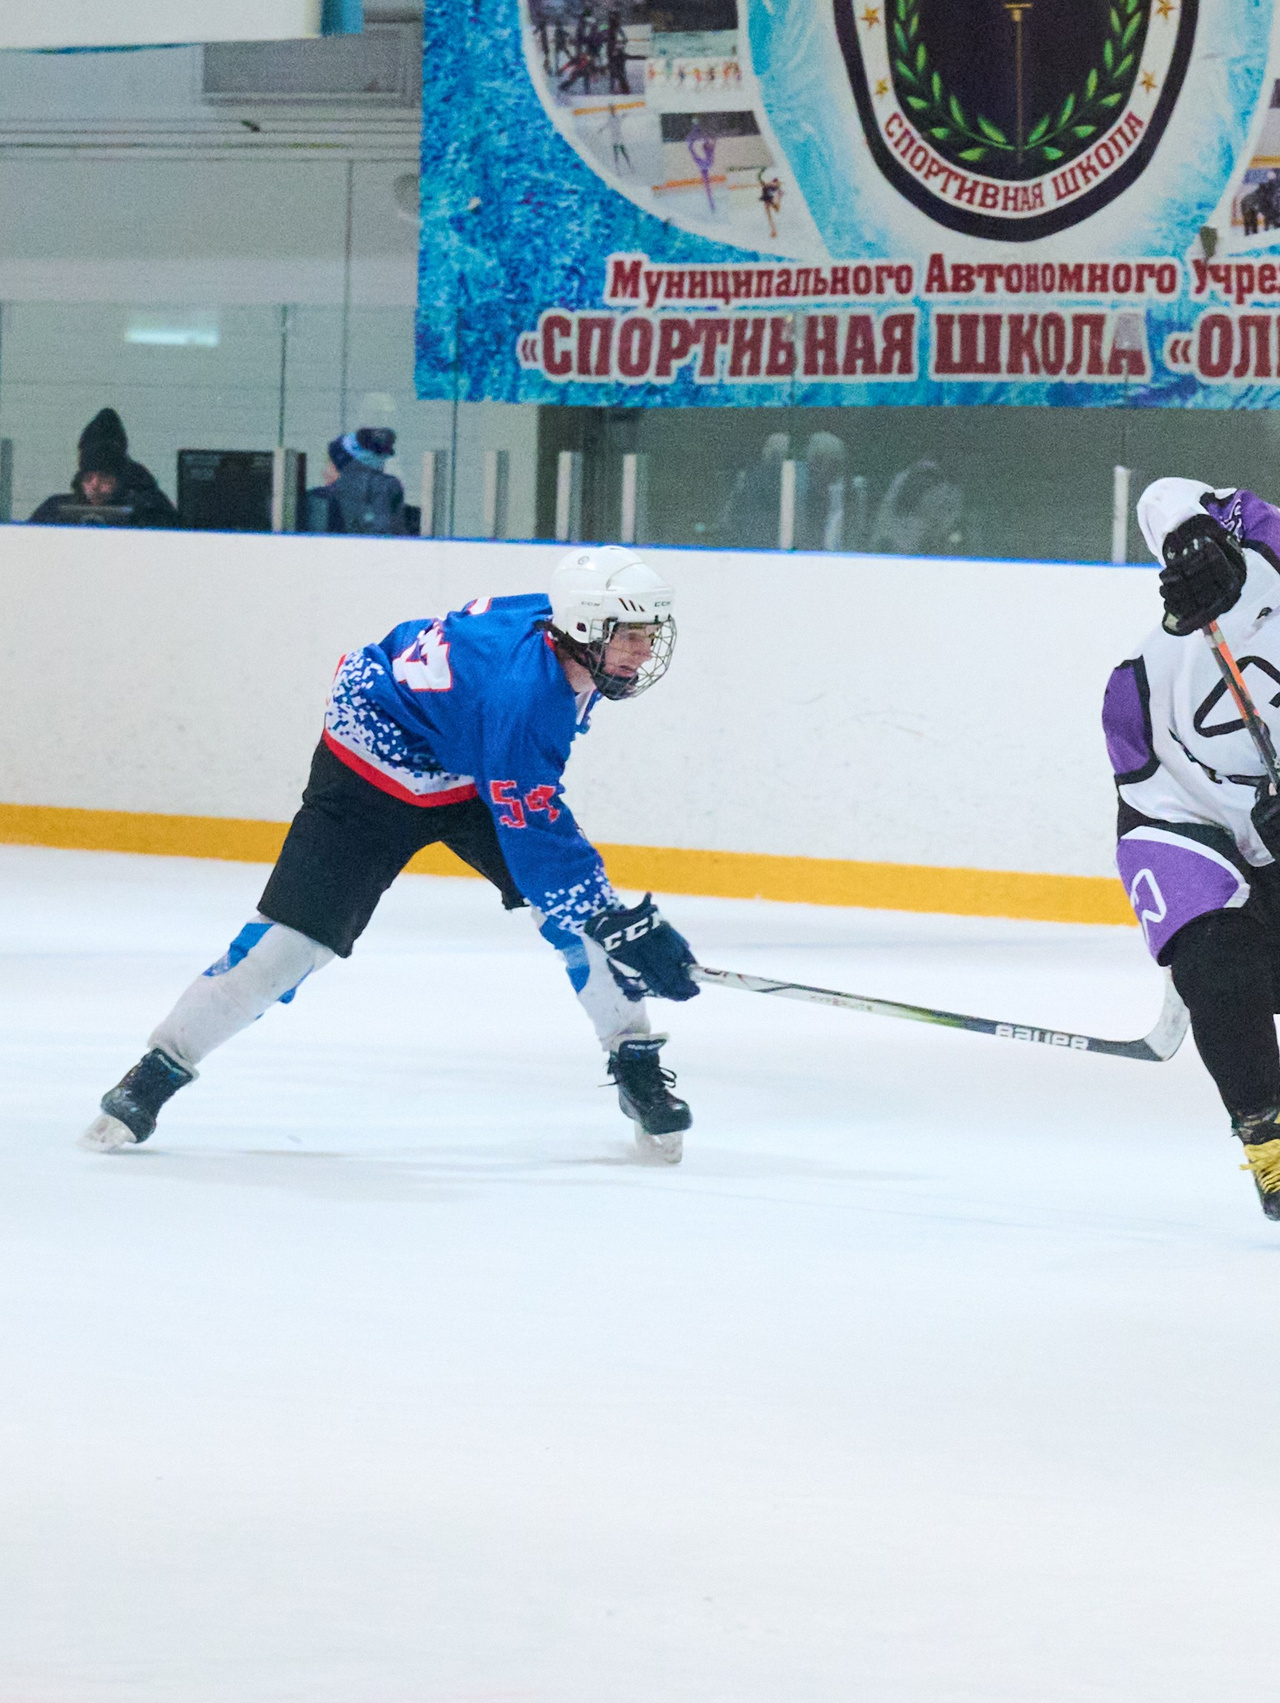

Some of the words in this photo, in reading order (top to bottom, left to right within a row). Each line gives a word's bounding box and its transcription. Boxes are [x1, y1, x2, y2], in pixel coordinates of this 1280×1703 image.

[884, 112, 1045, 212] СПОРТИВНАЯ
[1052, 110, 1144, 200] ШКОЛА
[610, 260, 913, 308] Муниципального
[925, 253, 1176, 294] Автономного
[934, 312, 1146, 376] ШКОЛА
[489, 780, 560, 829] 54
